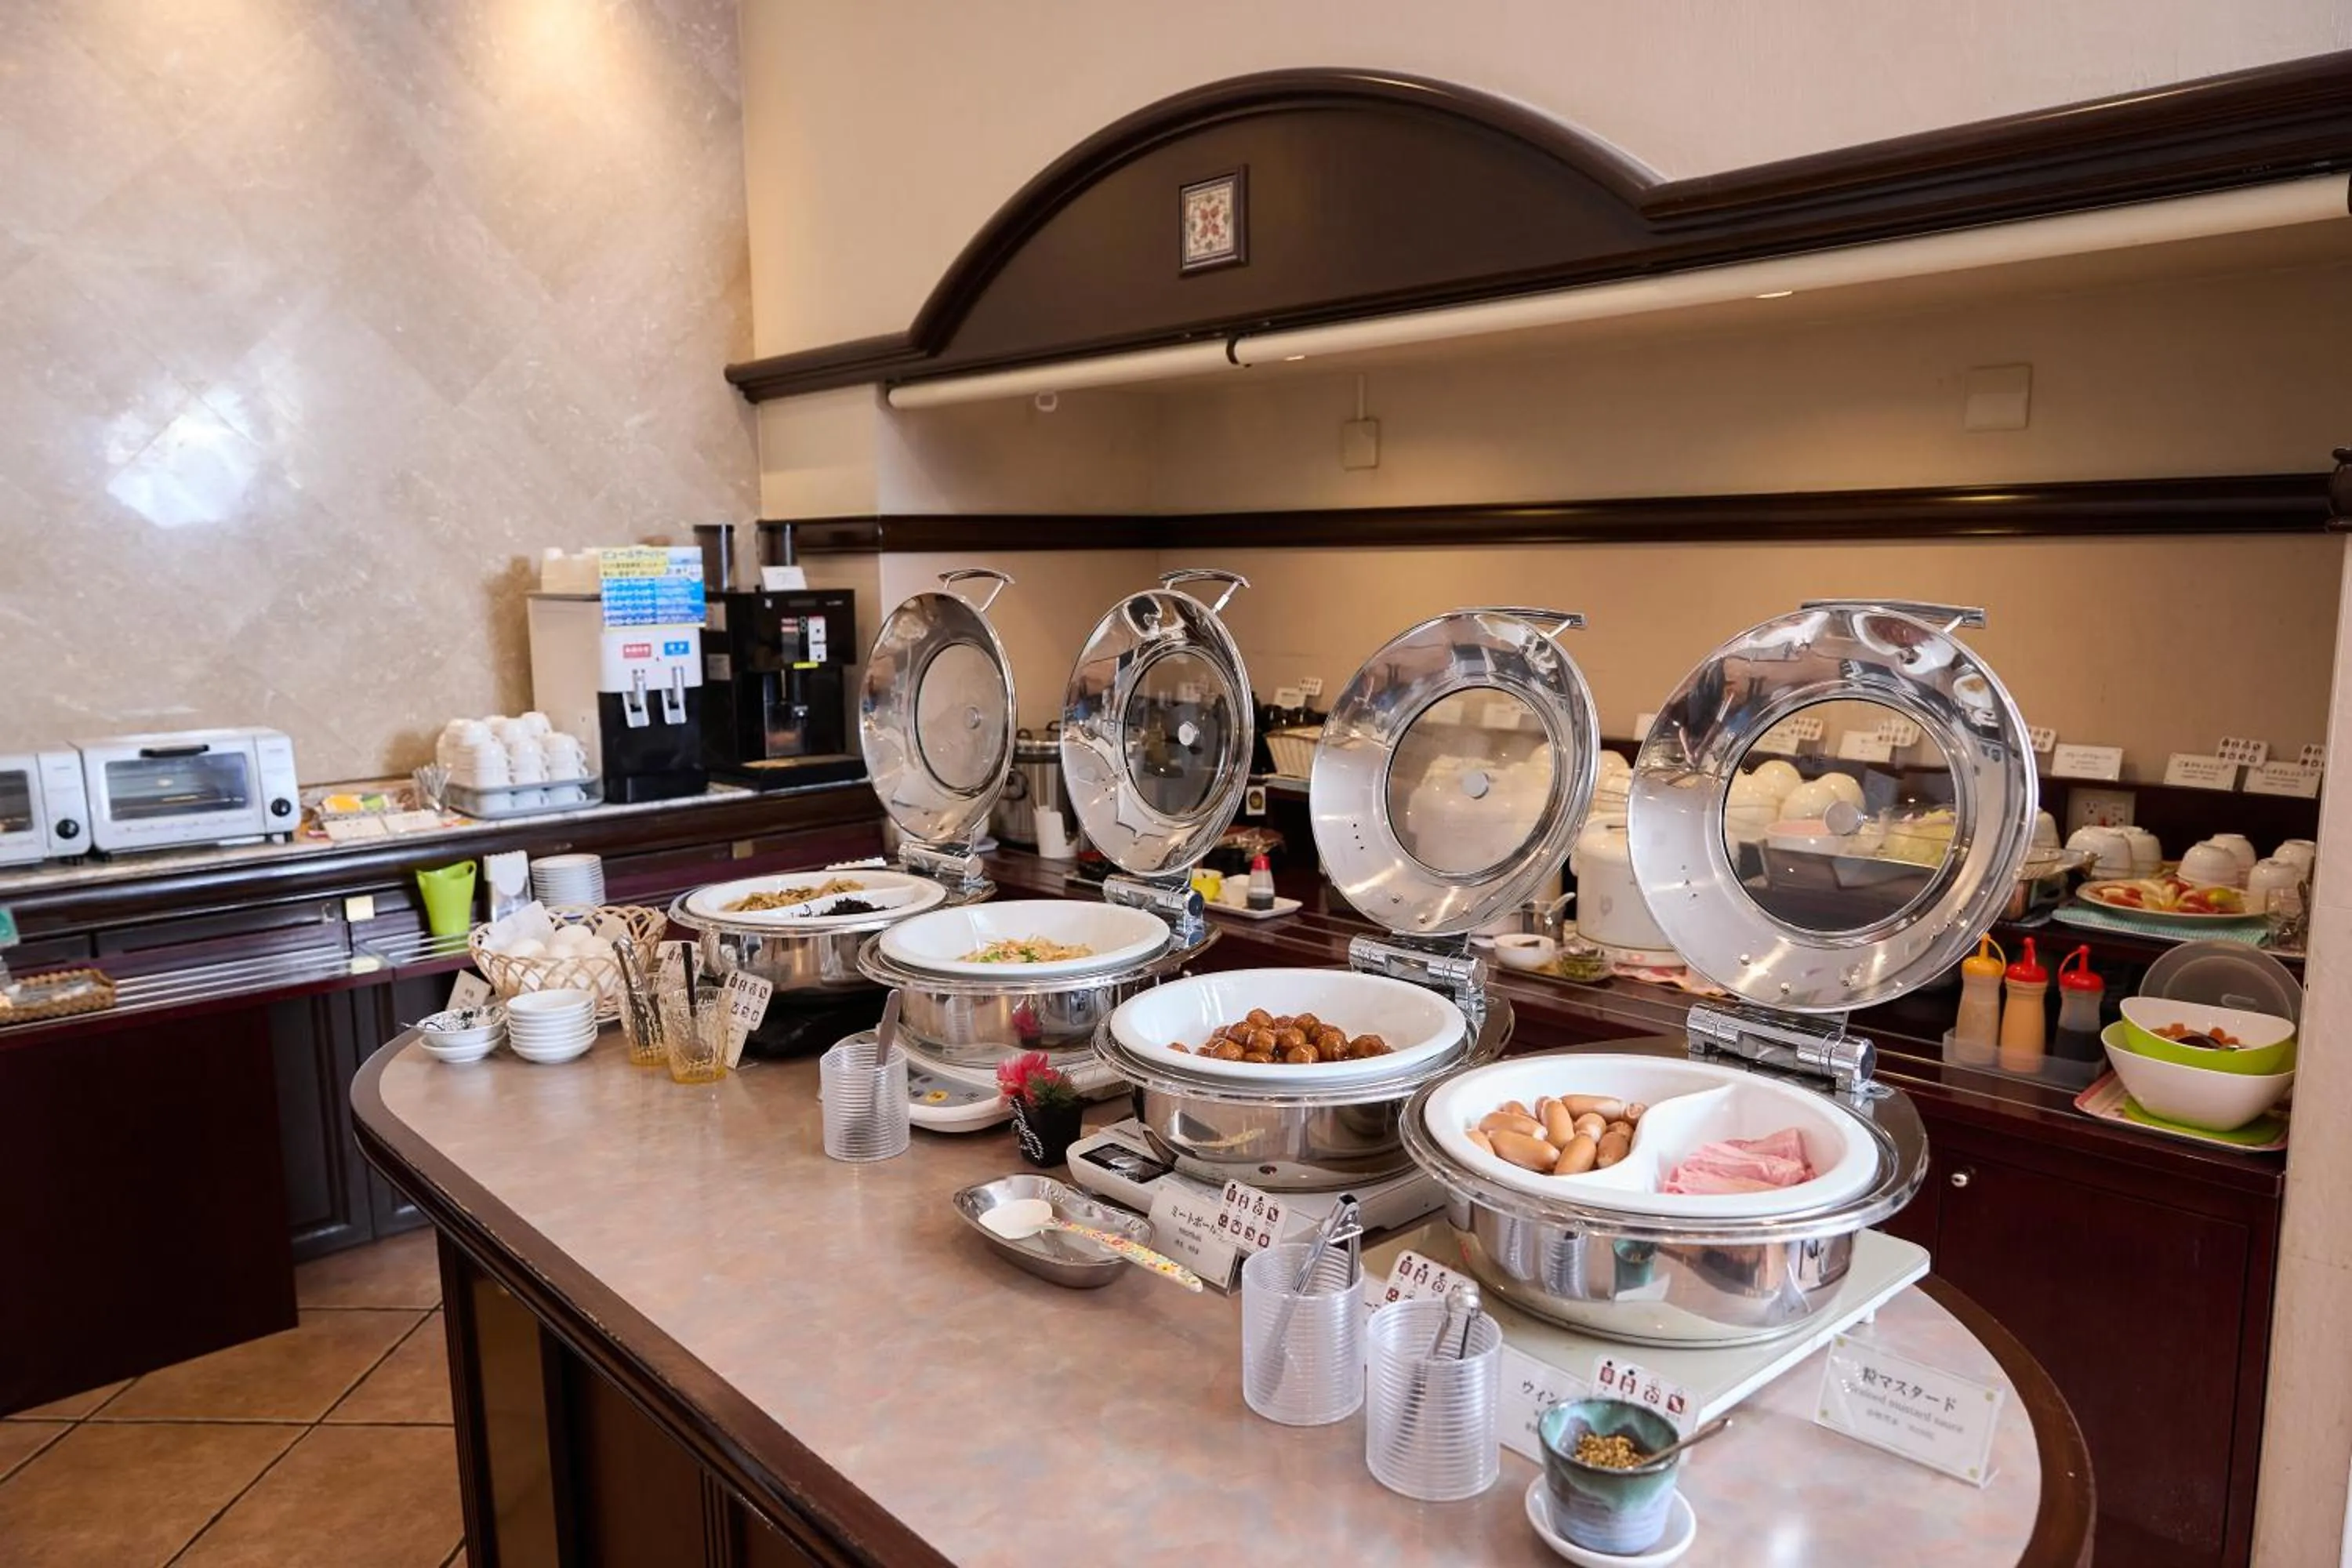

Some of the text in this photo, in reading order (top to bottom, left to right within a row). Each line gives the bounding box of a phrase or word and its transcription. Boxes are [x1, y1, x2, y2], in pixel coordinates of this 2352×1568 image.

[1862, 1367, 1957, 1412] 粒マスタード
